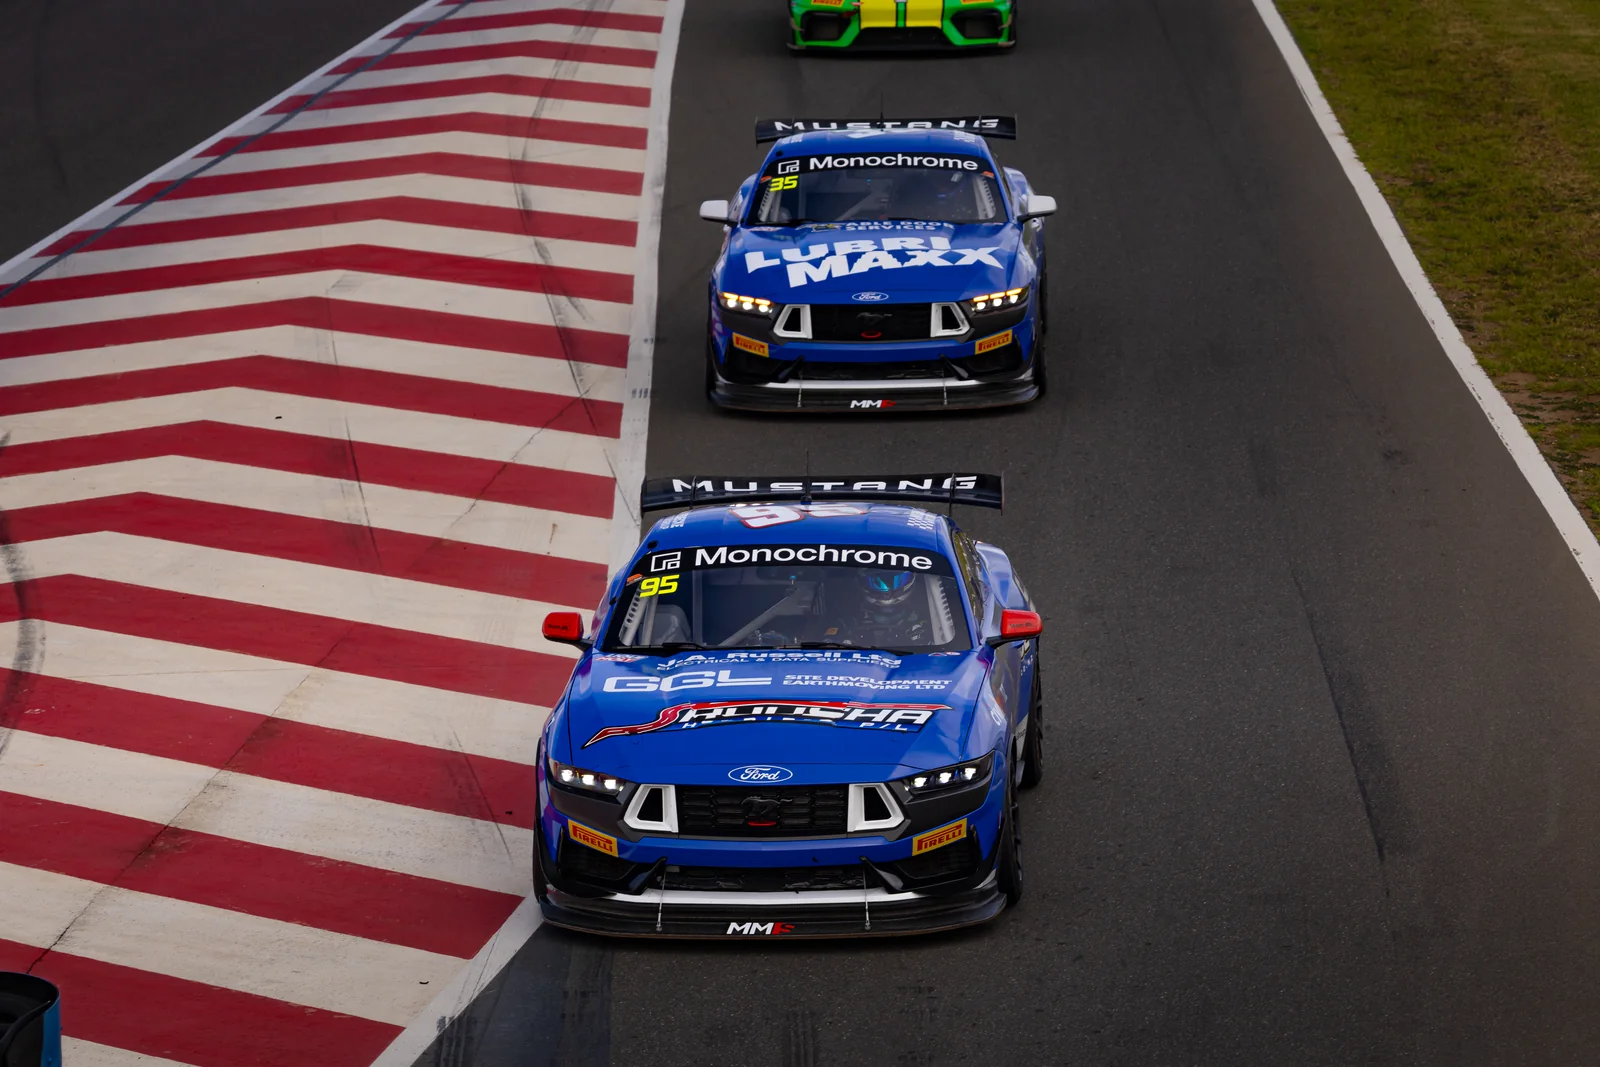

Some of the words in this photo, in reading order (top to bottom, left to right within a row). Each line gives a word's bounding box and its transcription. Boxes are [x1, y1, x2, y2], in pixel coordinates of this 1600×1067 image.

[774, 119, 1000, 131] MUSTANG
[809, 153, 979, 171] Monochrome
[769, 175, 799, 192] 35
[745, 236, 952, 274] LUBRI
[787, 246, 1004, 288] MAXX
[857, 292, 882, 301] Ford
[735, 336, 767, 355] PIRELLI
[978, 332, 1012, 353] PIRELLI
[671, 475, 977, 493] MUSTANG
[694, 544, 933, 570] Monochrome
[639, 574, 680, 598] 95
[816, 657, 900, 669] SUPPLIERS
[852, 653, 902, 666] Ltd
[602, 669, 773, 693] GGL
[782, 680, 911, 690] EARTHMOVING
[827, 675, 953, 686] DEVELOPMENT
[739, 767, 781, 782] Ford
[572, 824, 614, 854] PIRELLI
[916, 823, 968, 853] PIRELLI
